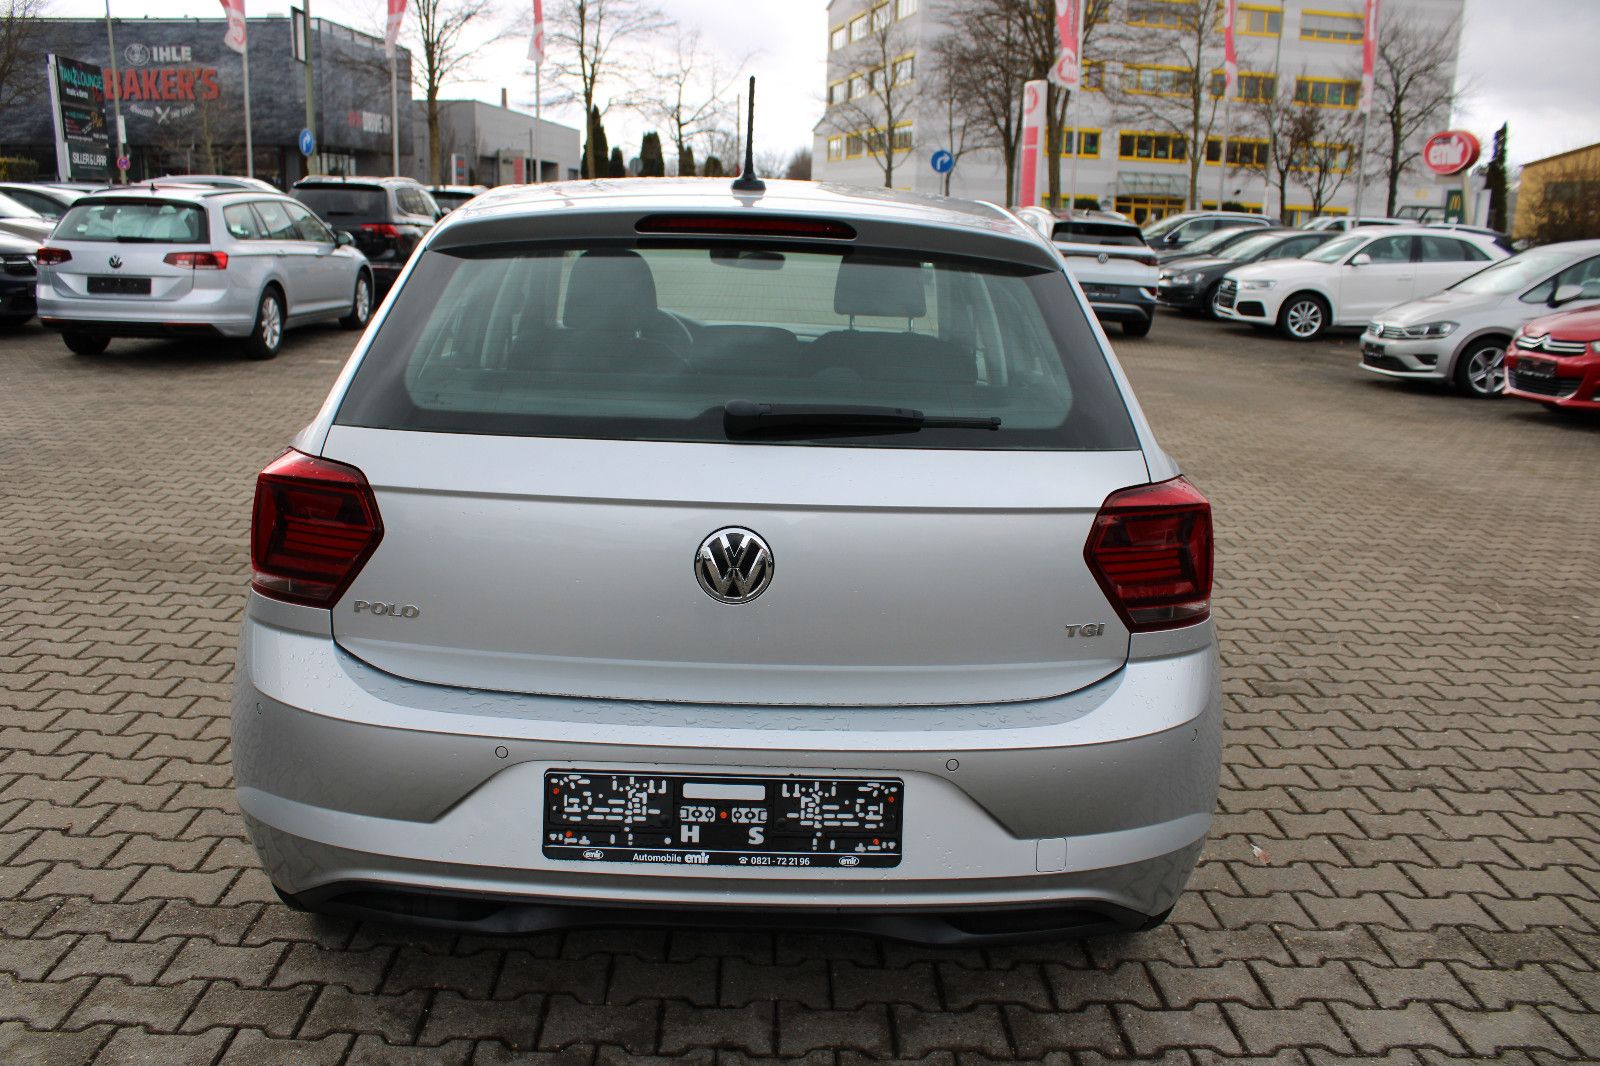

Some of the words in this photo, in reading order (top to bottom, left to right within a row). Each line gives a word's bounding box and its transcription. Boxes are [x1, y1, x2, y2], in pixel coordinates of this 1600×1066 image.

[152, 46, 192, 61] IHLE
[103, 67, 219, 100] BAKER'S
[353, 599, 420, 618] POLO
[1065, 622, 1106, 638] TGI
[632, 852, 682, 863] Automobile
[684, 852, 710, 864] emir
